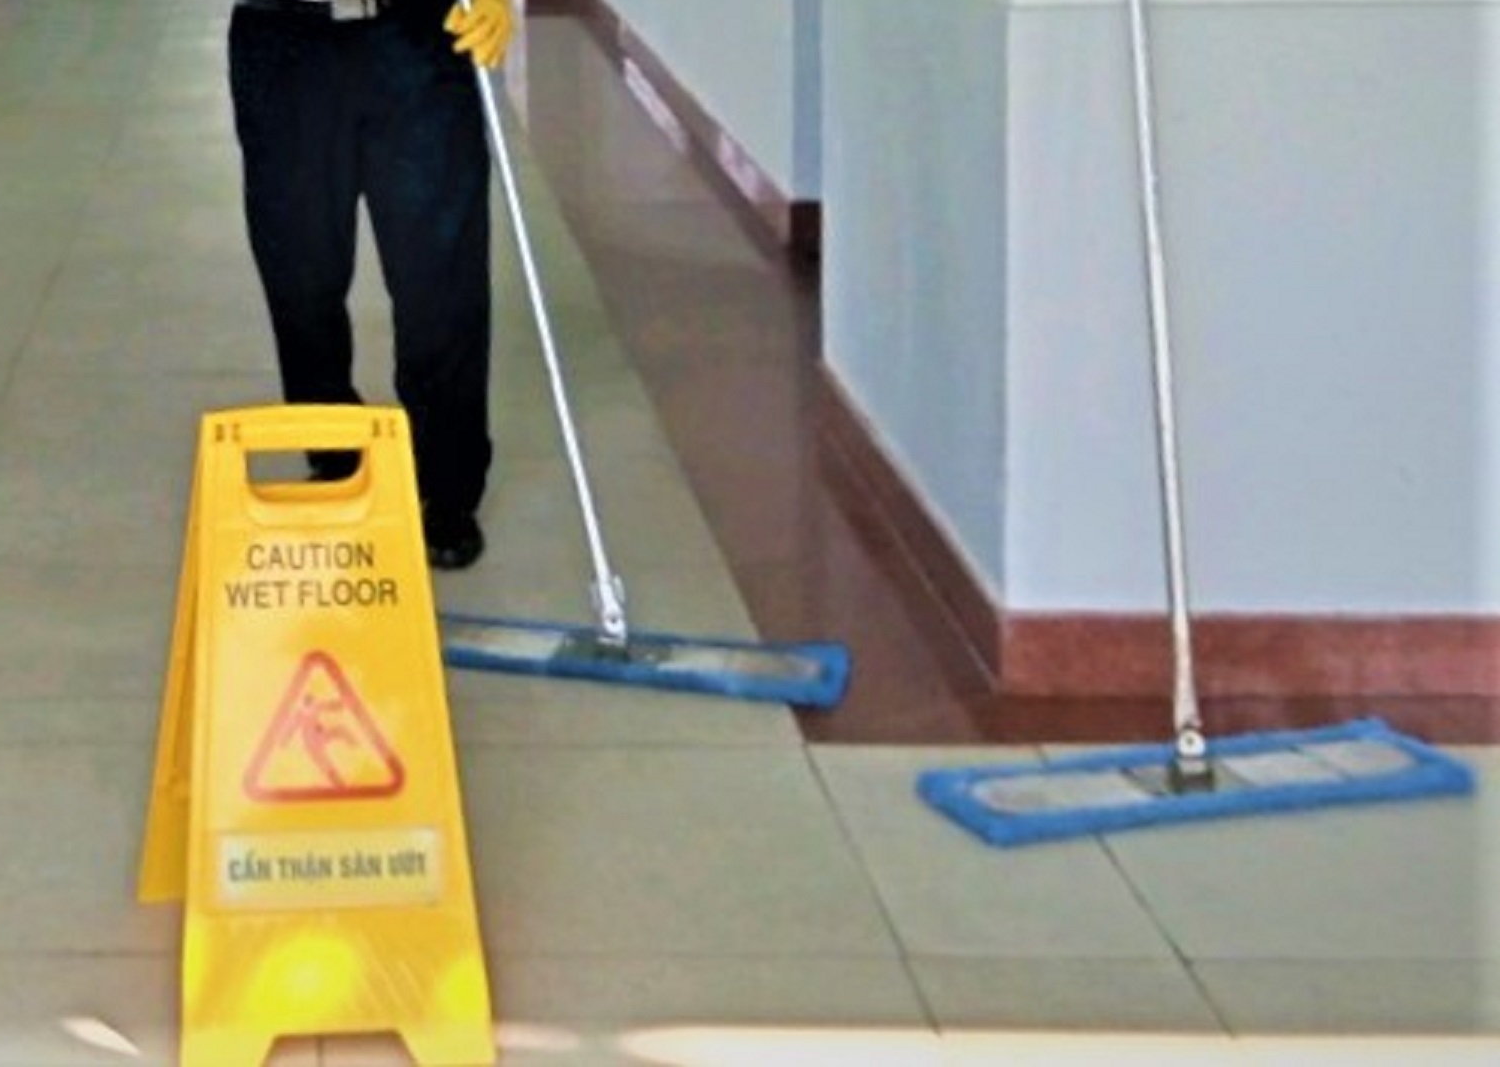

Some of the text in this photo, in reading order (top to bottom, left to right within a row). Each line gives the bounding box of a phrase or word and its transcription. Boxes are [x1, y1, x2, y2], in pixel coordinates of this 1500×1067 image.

[247, 542, 375, 570] CAUTION
[225, 579, 398, 608] WET FLOOR
